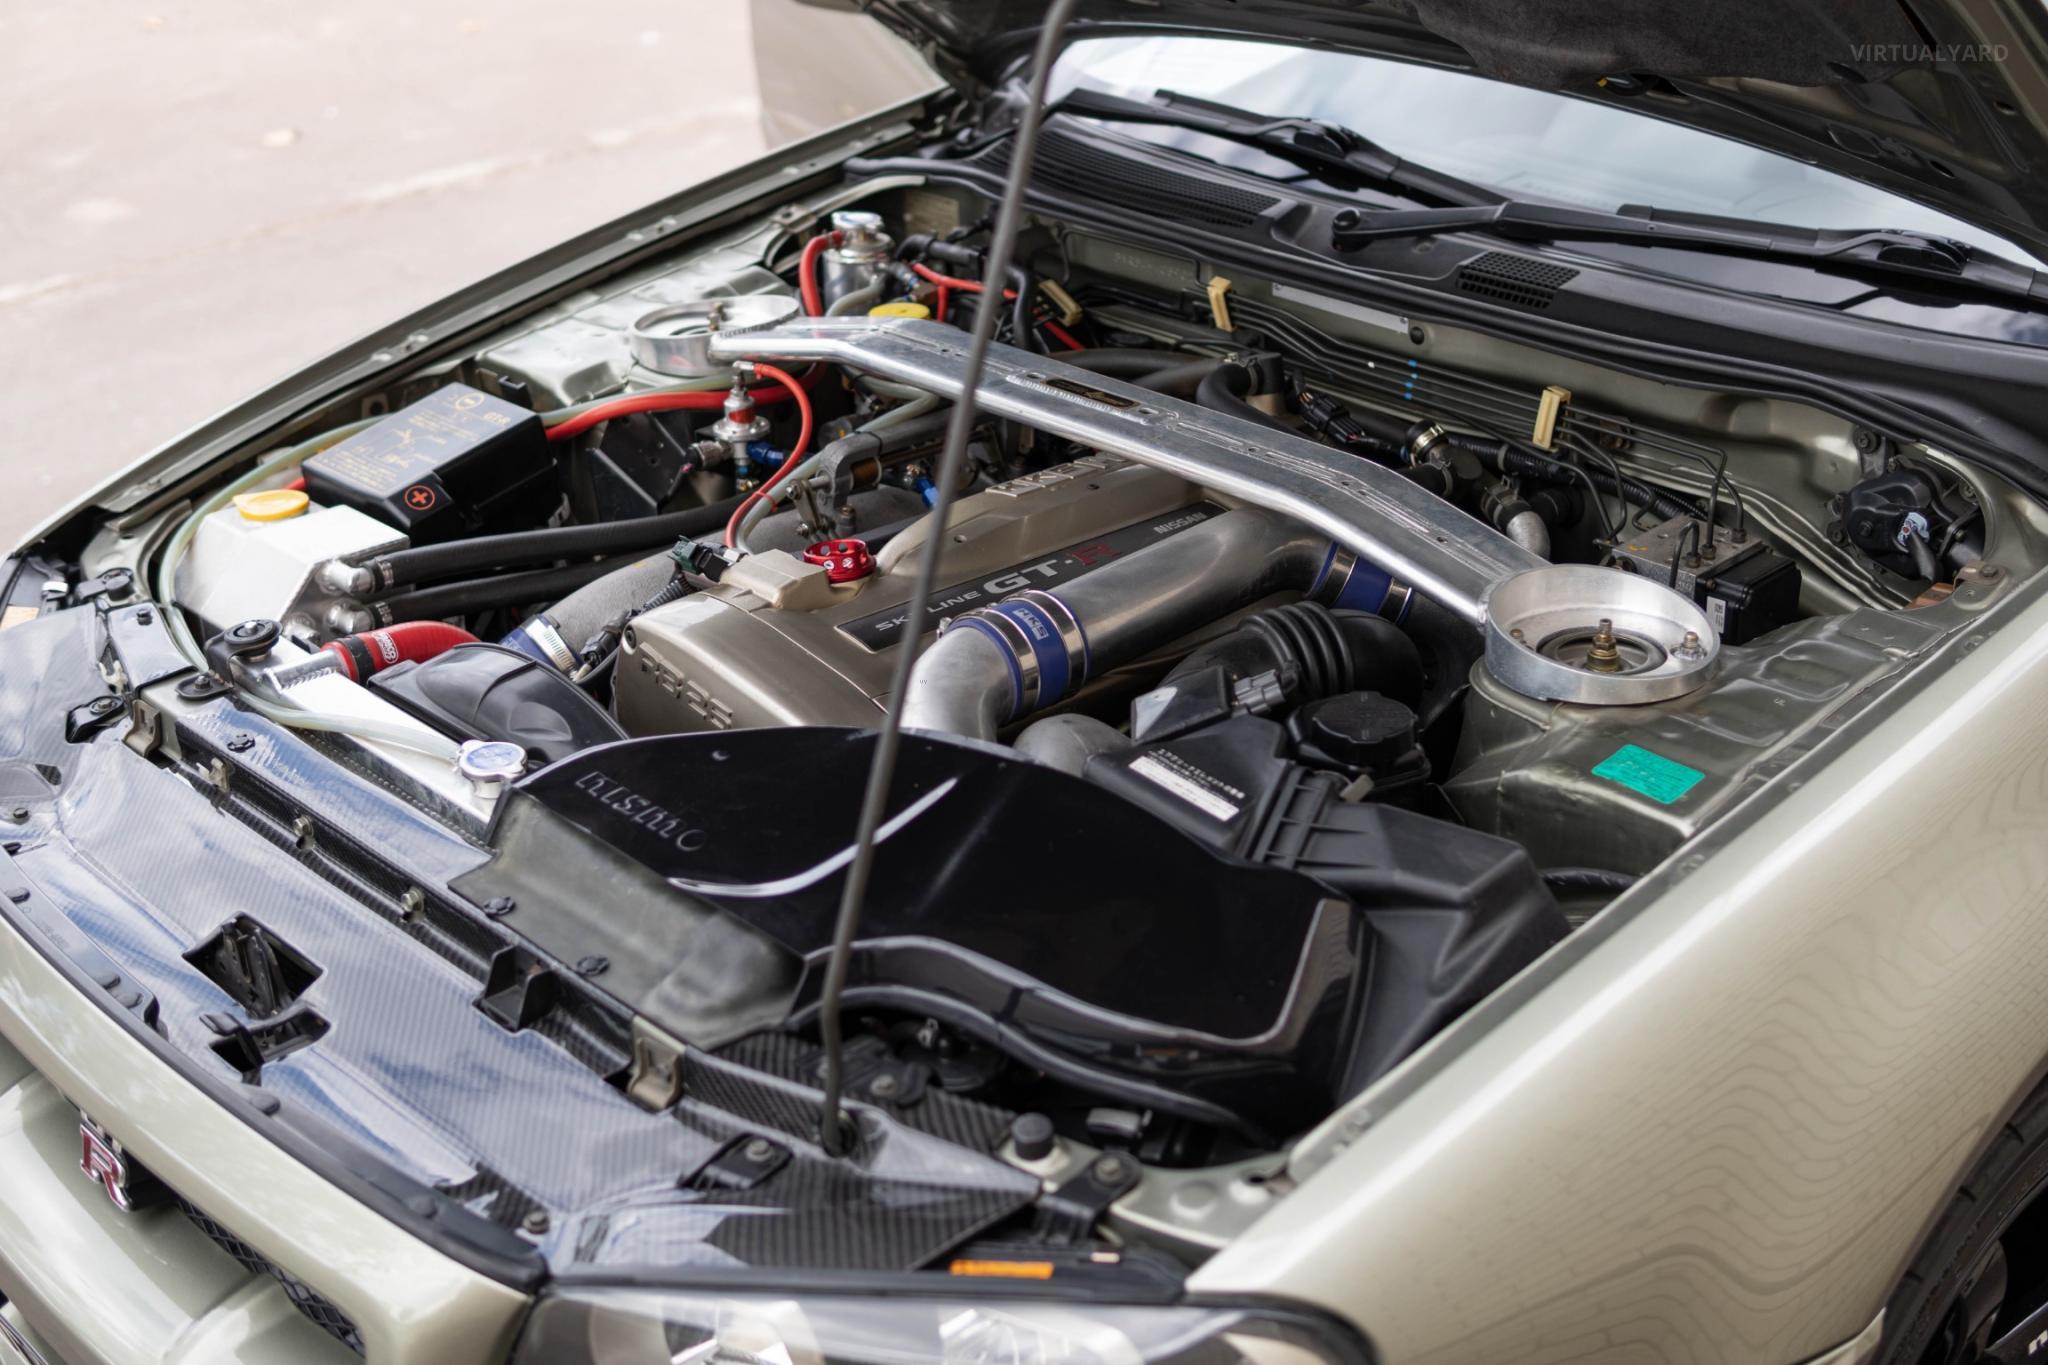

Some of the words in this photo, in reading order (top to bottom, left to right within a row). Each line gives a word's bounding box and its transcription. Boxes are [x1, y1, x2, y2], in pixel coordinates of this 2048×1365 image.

[1153, 511, 1208, 534] NISSAN
[875, 590, 982, 631] SKLINE
[1012, 608, 1049, 641] HKS
